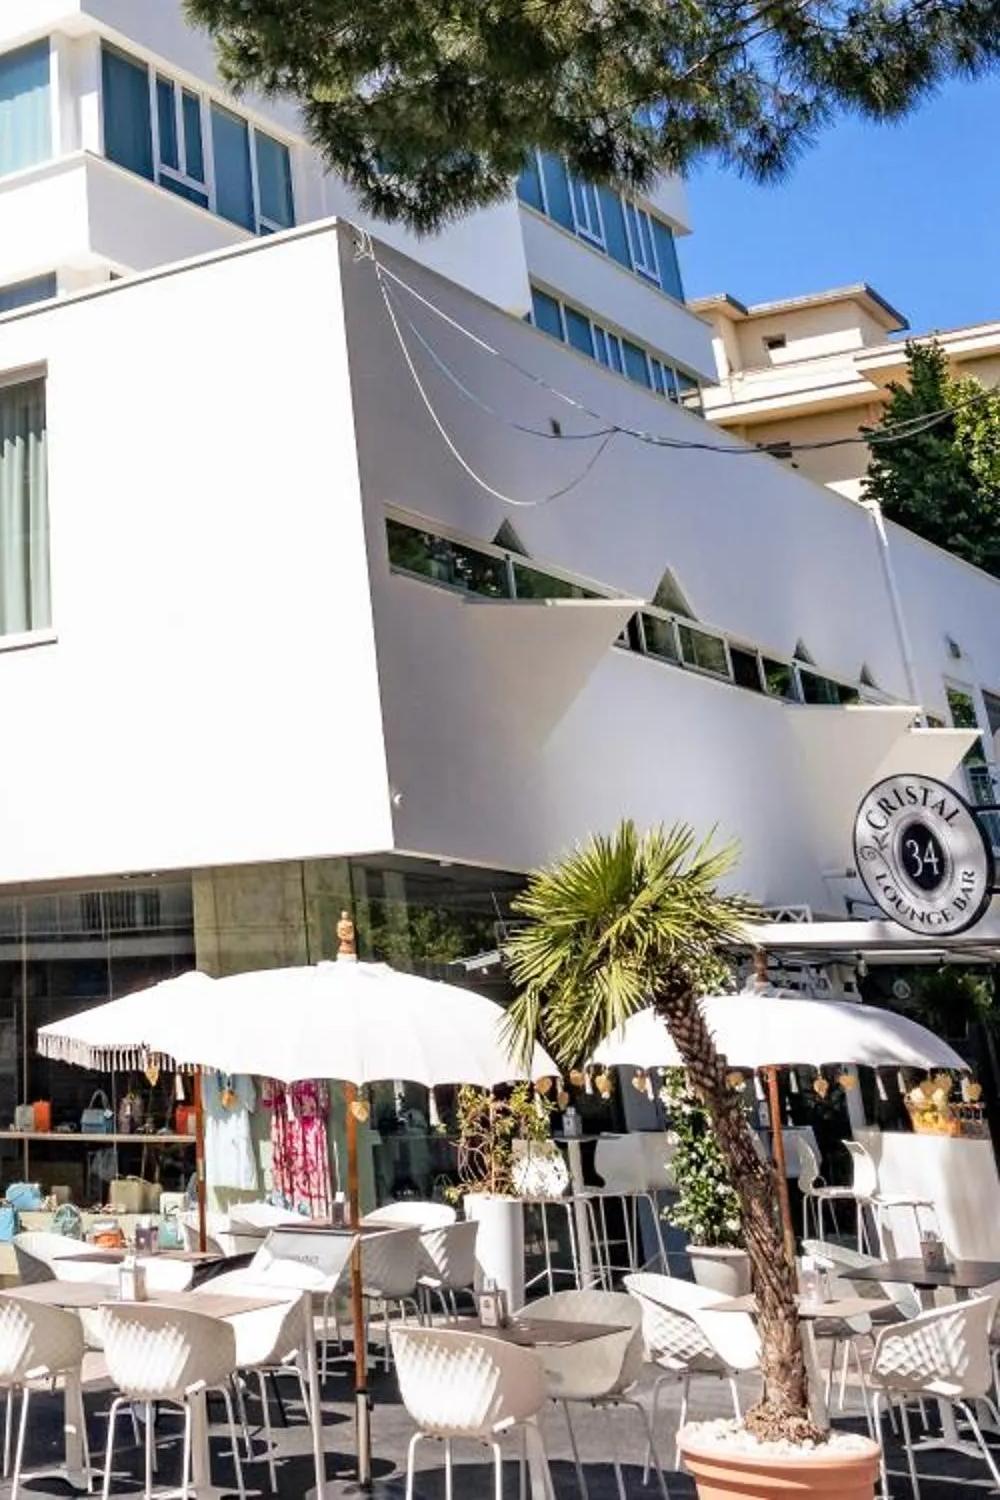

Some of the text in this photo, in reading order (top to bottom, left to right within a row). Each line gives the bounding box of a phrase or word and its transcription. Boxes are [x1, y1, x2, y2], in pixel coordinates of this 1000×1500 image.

[865, 785, 961, 831] CRISTAL
[905, 839, 939, 877] 34
[875, 871, 976, 925] LOUNGE BAR
